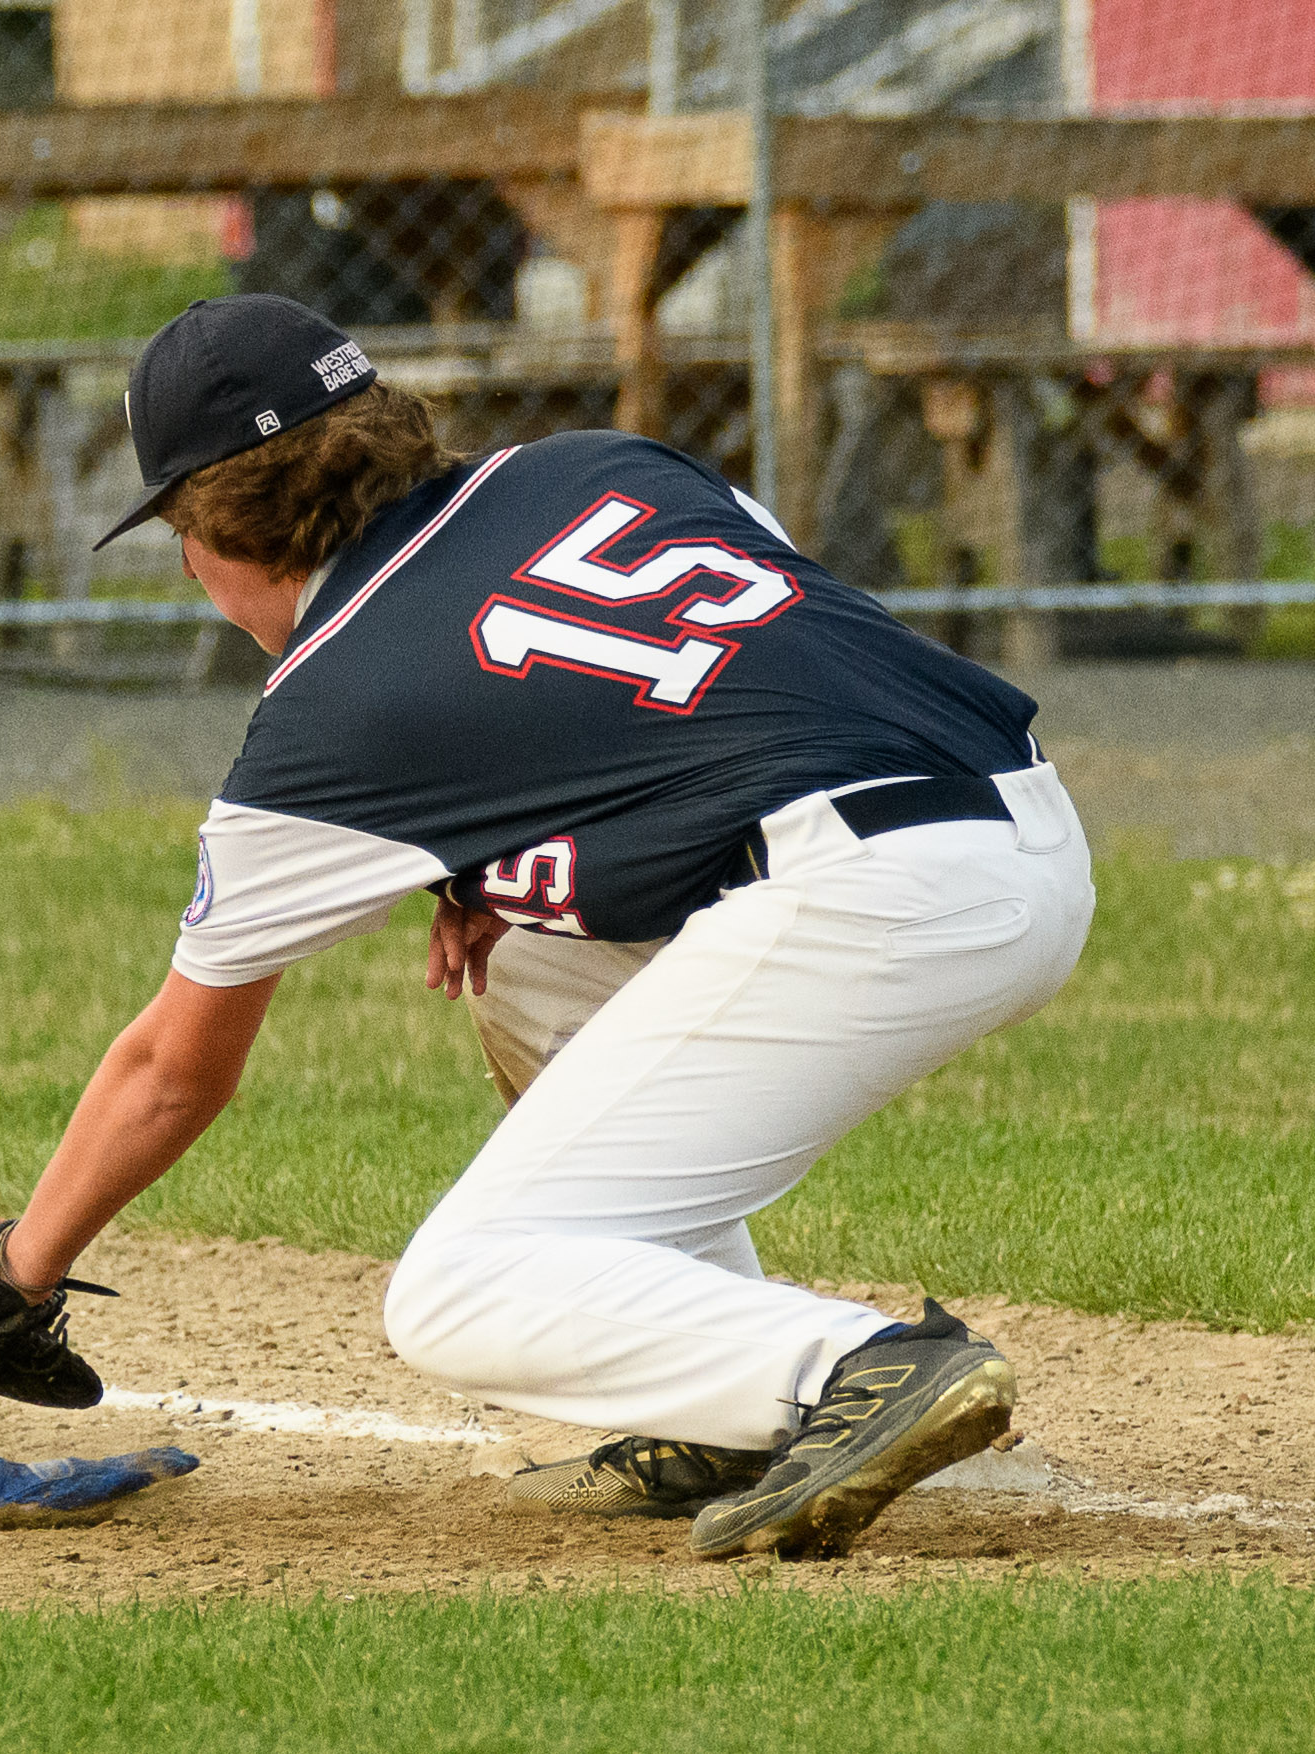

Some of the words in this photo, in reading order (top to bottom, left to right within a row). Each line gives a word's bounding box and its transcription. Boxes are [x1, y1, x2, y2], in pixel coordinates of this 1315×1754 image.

[322, 364, 358, 392] BABE
[468, 489, 805, 716] 15
[562, 1488, 605, 1500] adidas
